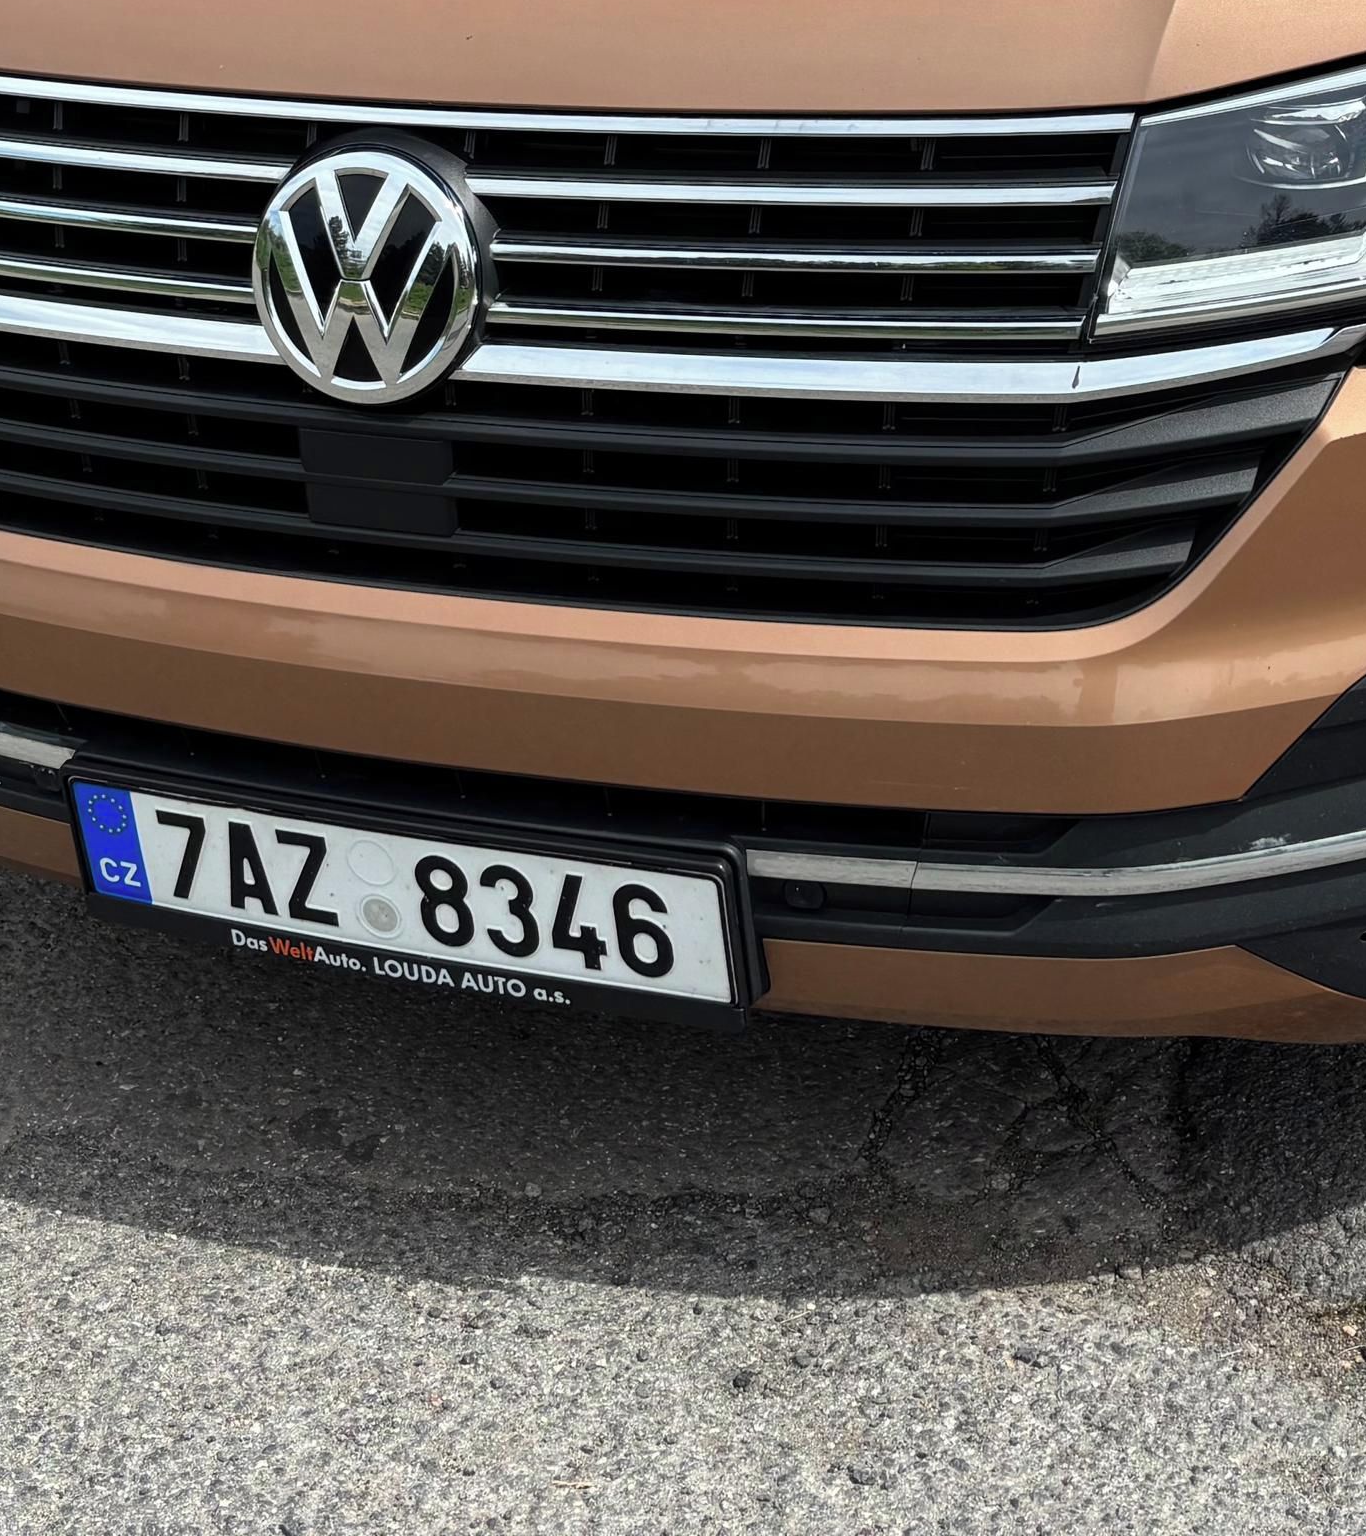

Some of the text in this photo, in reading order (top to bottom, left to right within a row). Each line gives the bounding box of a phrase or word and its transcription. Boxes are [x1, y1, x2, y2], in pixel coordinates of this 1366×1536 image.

[98, 857, 142, 888] CZ
[155, 809, 675, 979] 7AZ 8346
[373, 957, 455, 987] LOUDA
[461, 972, 527, 998] AUTO
[533, 987, 572, 1005] a.s.
